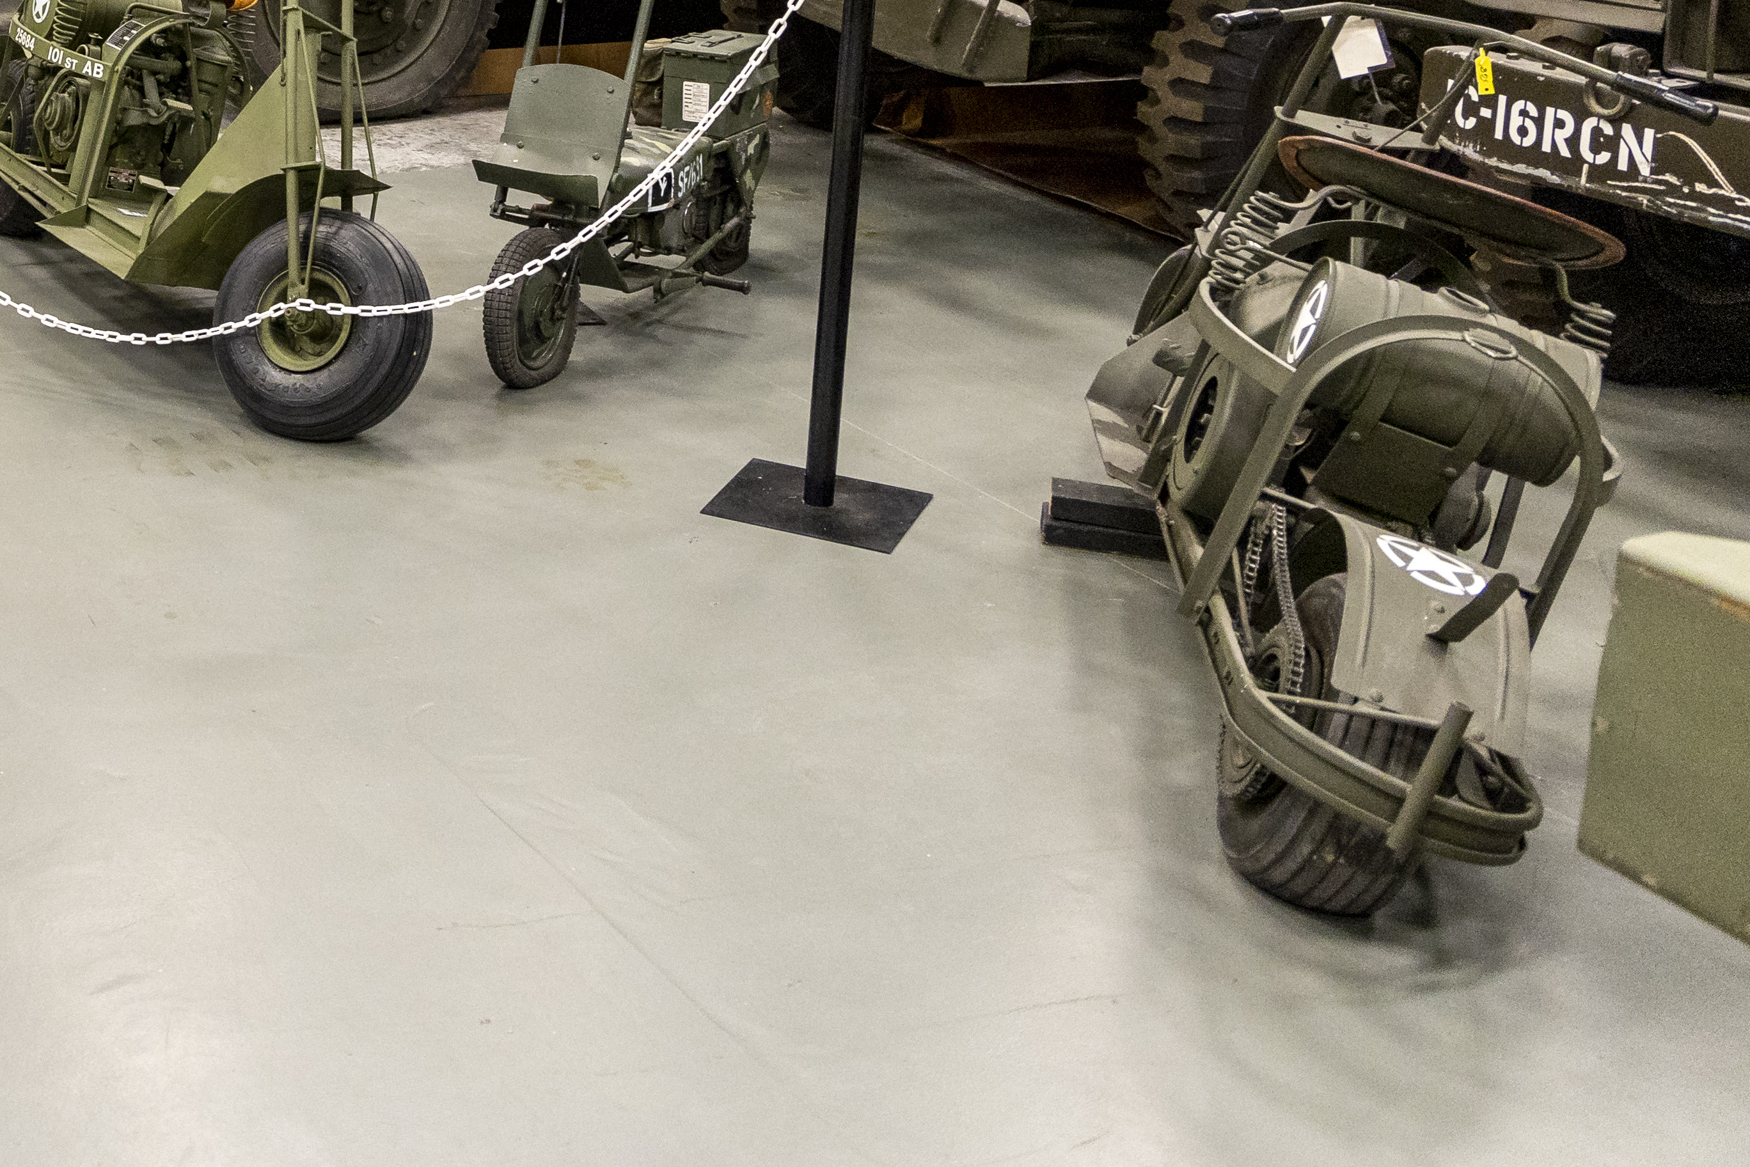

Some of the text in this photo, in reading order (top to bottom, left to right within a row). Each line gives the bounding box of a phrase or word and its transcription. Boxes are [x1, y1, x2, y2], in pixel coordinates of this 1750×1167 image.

[15, 27, 104, 78] 25684 101 ST AB
